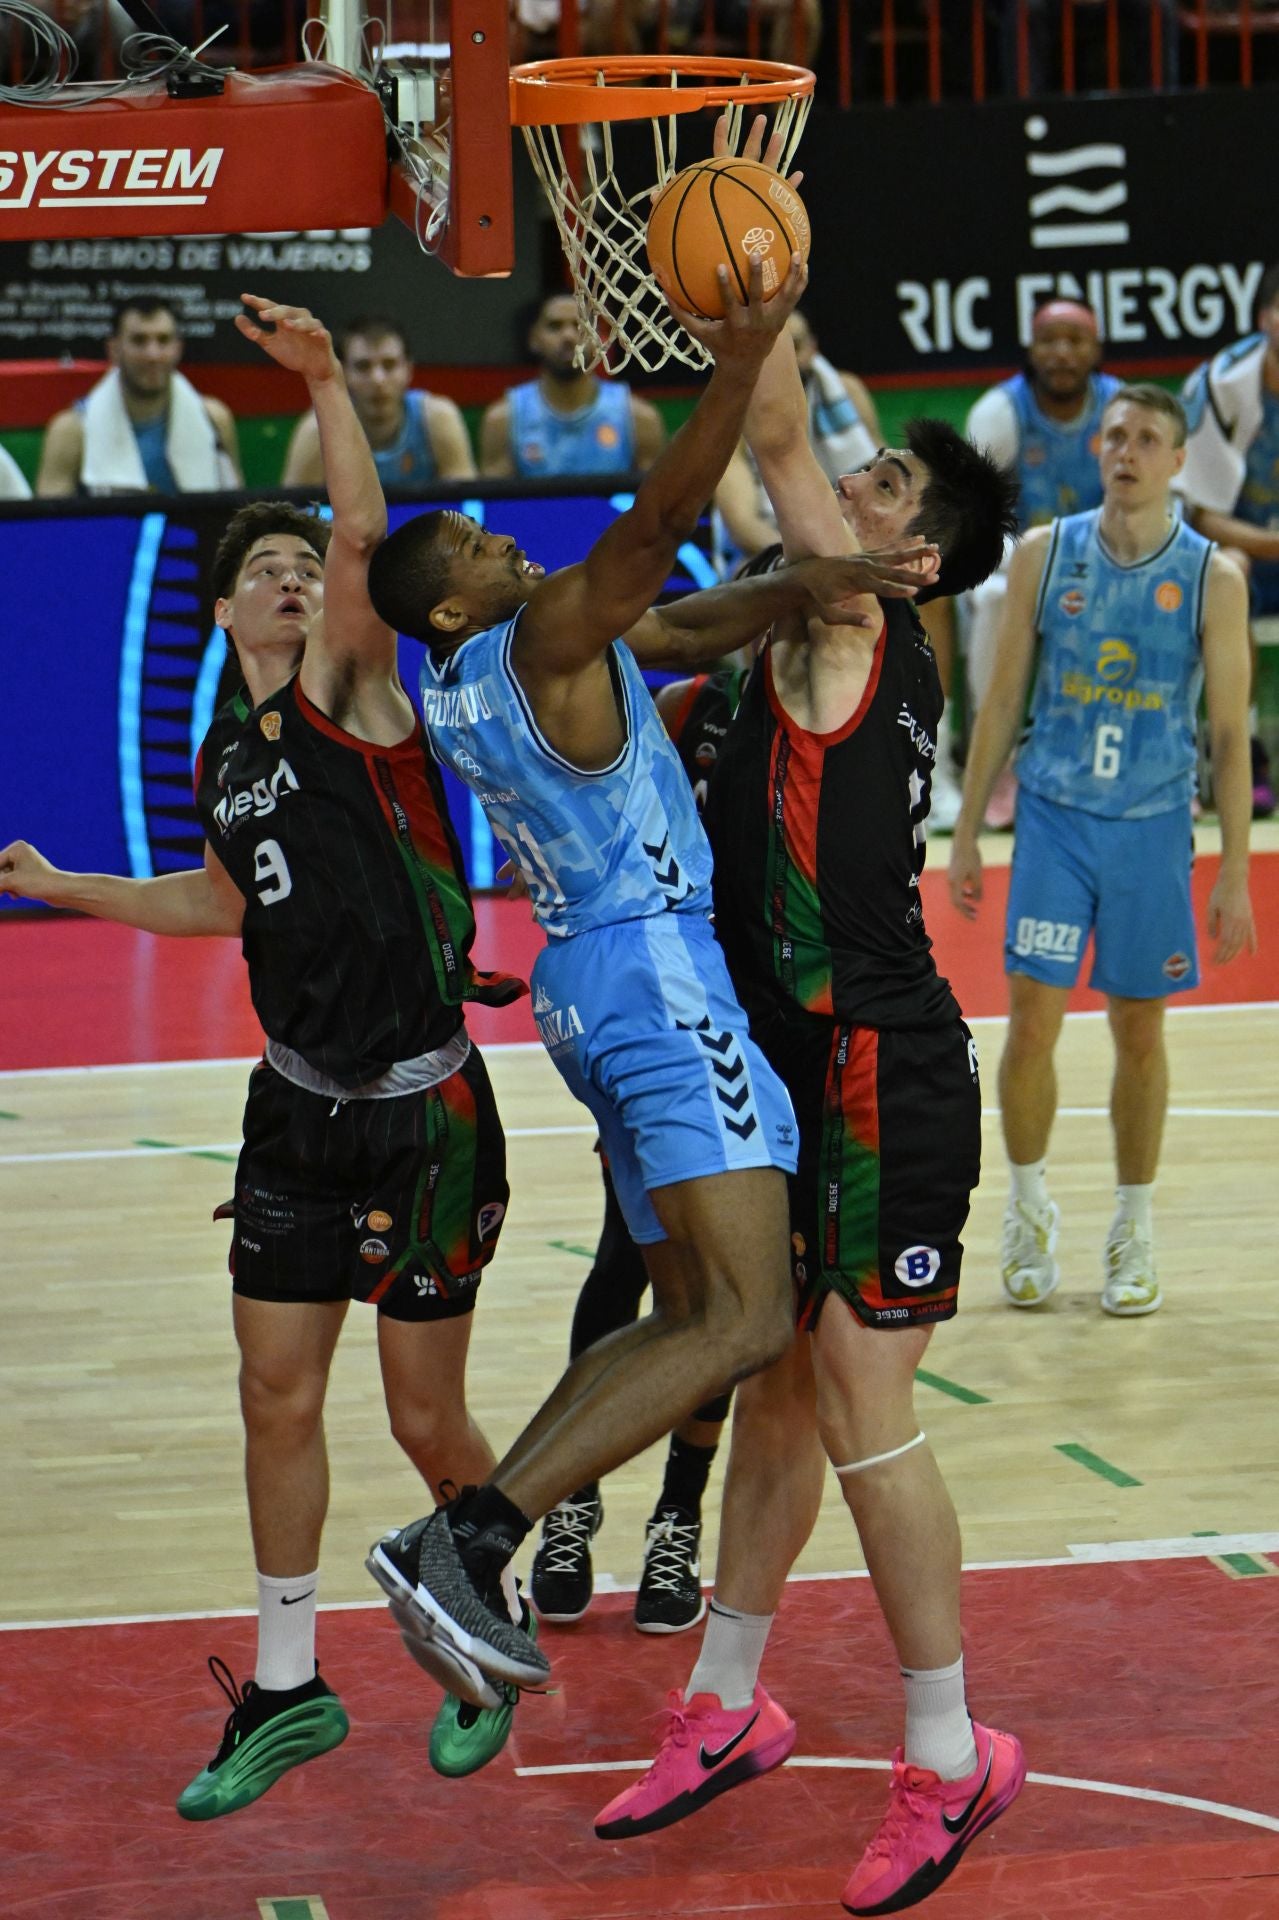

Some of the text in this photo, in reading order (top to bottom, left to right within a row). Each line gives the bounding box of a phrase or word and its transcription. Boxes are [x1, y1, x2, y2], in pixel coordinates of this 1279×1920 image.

[29, 241, 372, 272] SABEMOS DE VIAJEROS
[896, 262, 1265, 353] RIC ENERGY
[1093, 725, 1123, 779] 6
[254, 838, 293, 907] 9
[1014, 916, 1082, 956] gaza
[442, 942, 457, 973] 39300
[828, 1181, 838, 1213] 39300
[241, 1236, 262, 1253] vive
[906, 1252, 931, 1281] B
